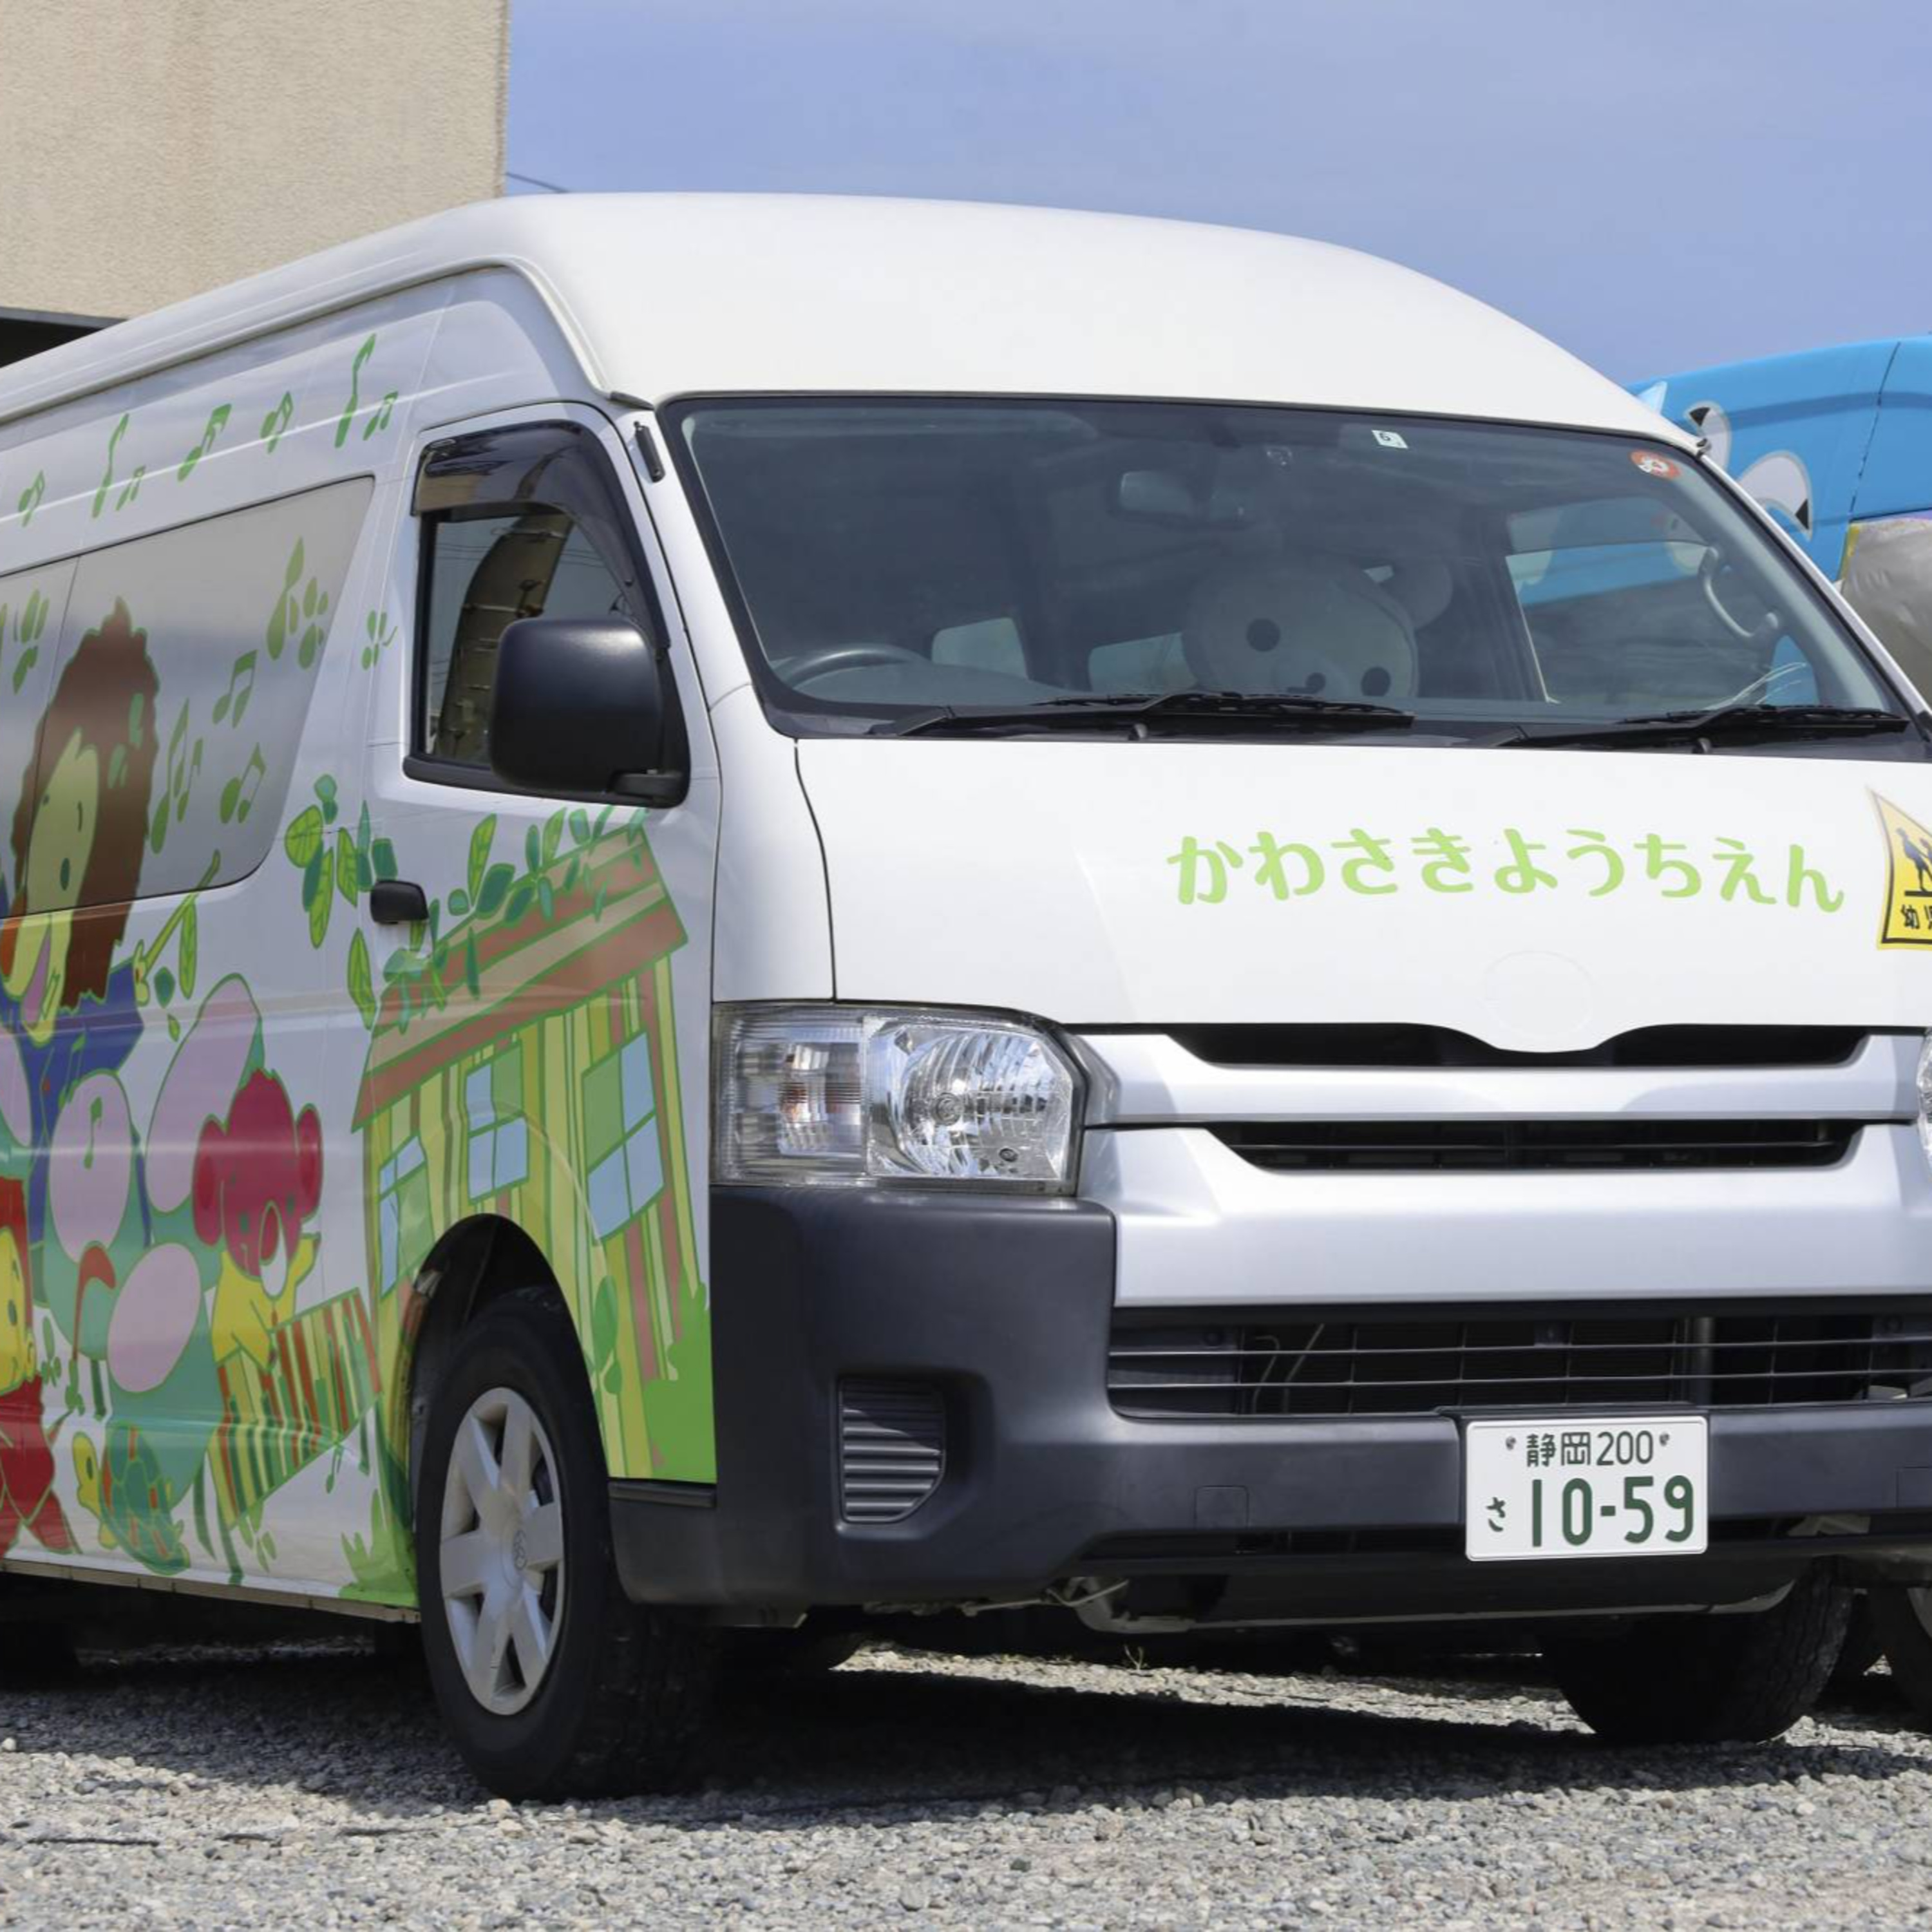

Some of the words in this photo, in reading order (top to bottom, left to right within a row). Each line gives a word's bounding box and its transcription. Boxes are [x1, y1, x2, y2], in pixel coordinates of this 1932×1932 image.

[1167, 828, 1844, 913] かわさきようちえん
[1486, 1497, 1506, 1532] さ
[1532, 1475, 1694, 1548] 10-59
